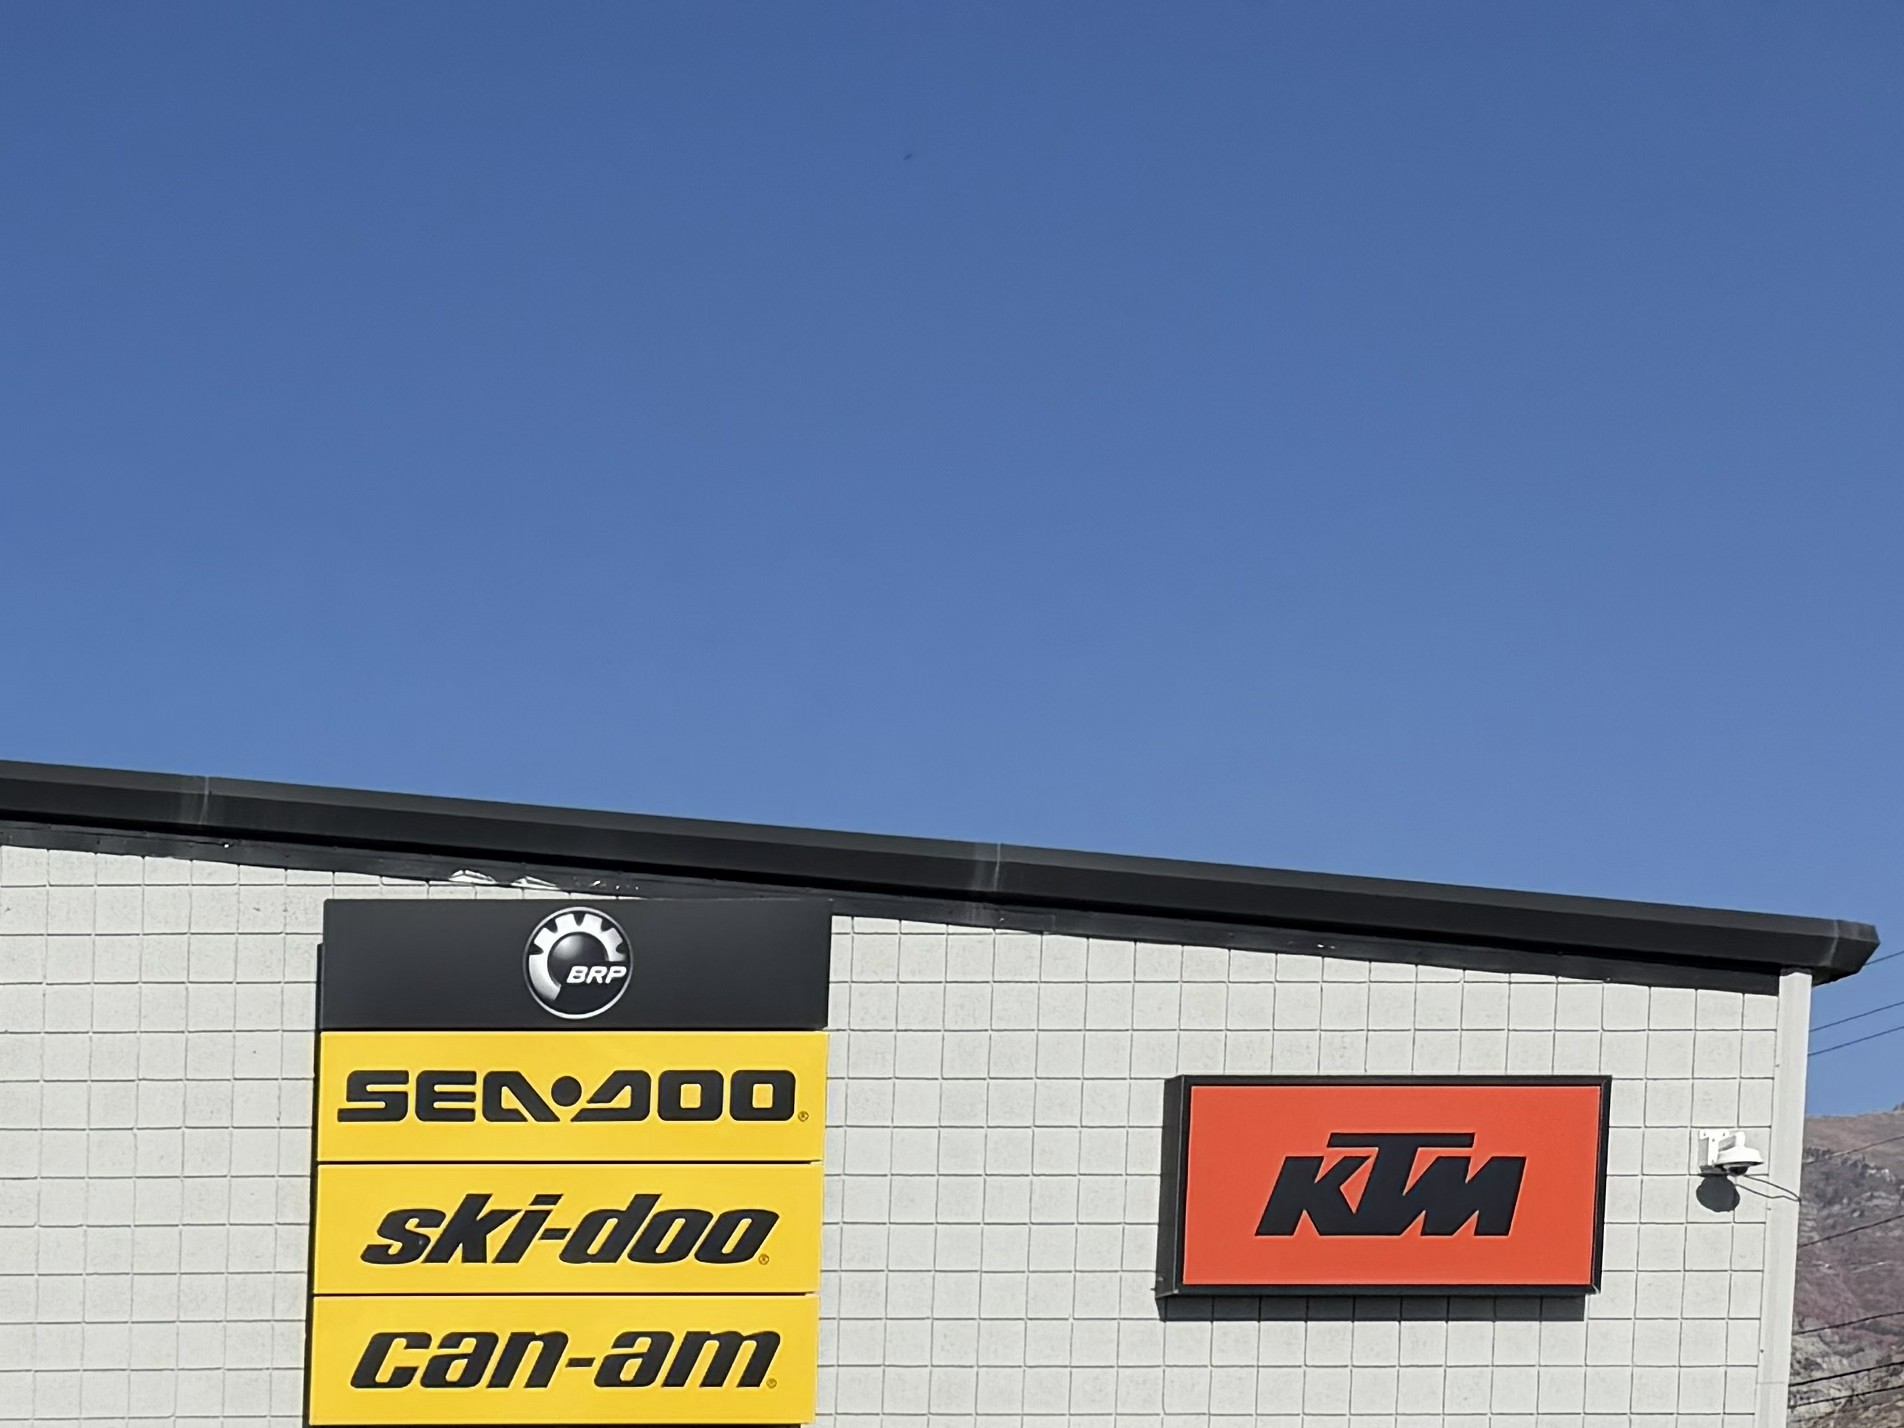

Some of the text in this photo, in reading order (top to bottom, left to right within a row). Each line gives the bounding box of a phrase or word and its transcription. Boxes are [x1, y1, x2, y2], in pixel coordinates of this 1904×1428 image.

[566, 964, 628, 985] BRP
[1254, 1131, 1528, 1237] KTM
[360, 1192, 780, 1264] ski-doo
[349, 1330, 782, 1389] can-am
